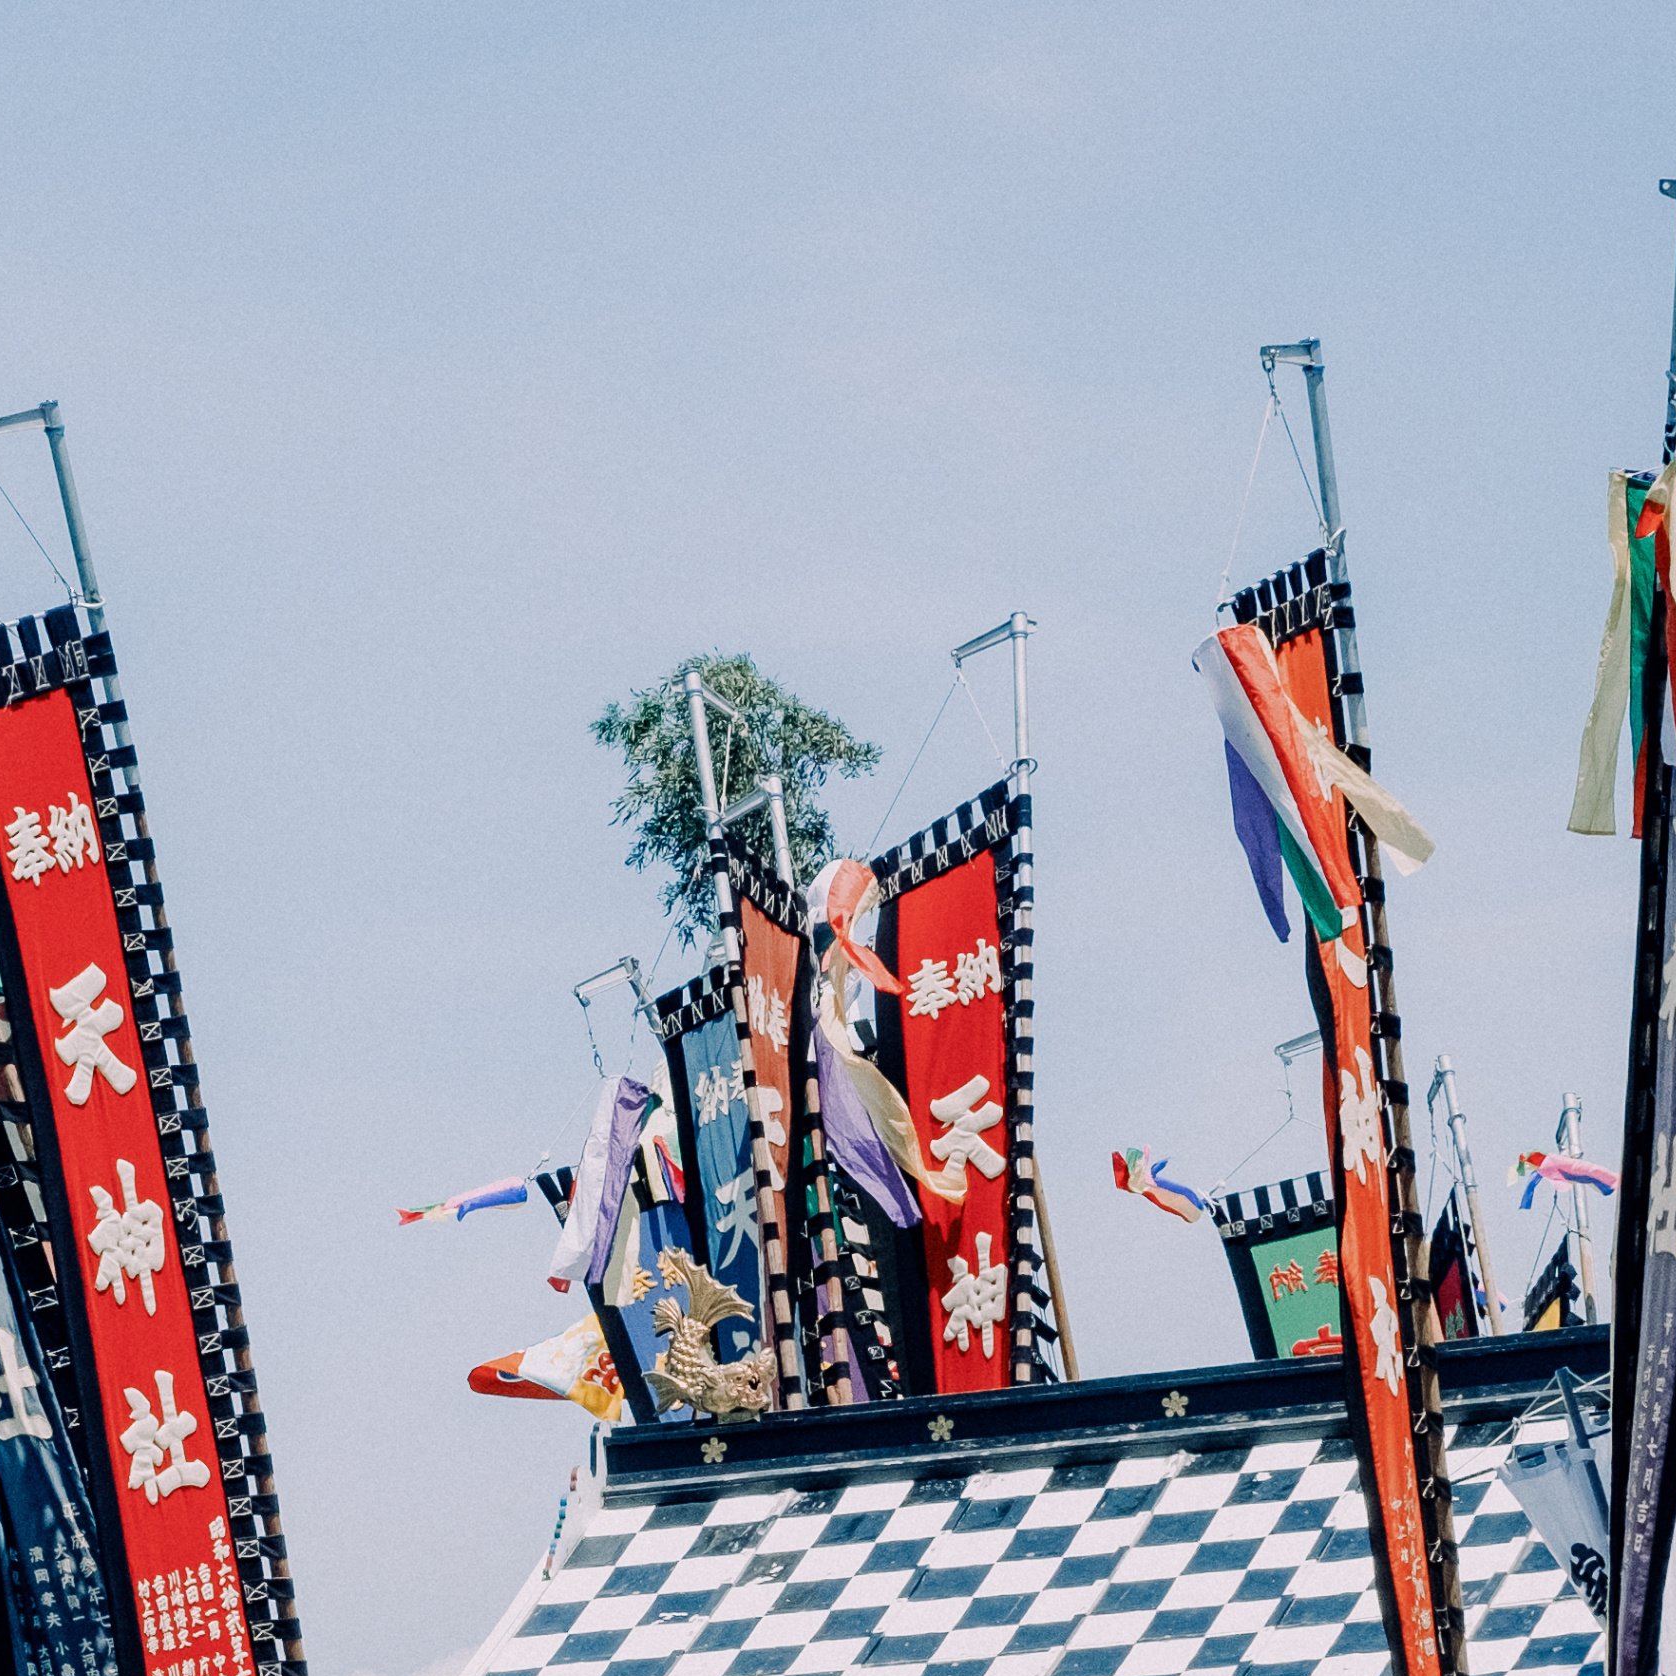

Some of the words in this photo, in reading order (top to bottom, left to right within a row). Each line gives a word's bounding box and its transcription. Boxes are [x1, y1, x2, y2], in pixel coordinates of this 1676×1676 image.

[5, 792, 100, 886] 奉納
[905, 938, 1002, 1019] 奉納
[49, 962, 212, 1504] 天神社
